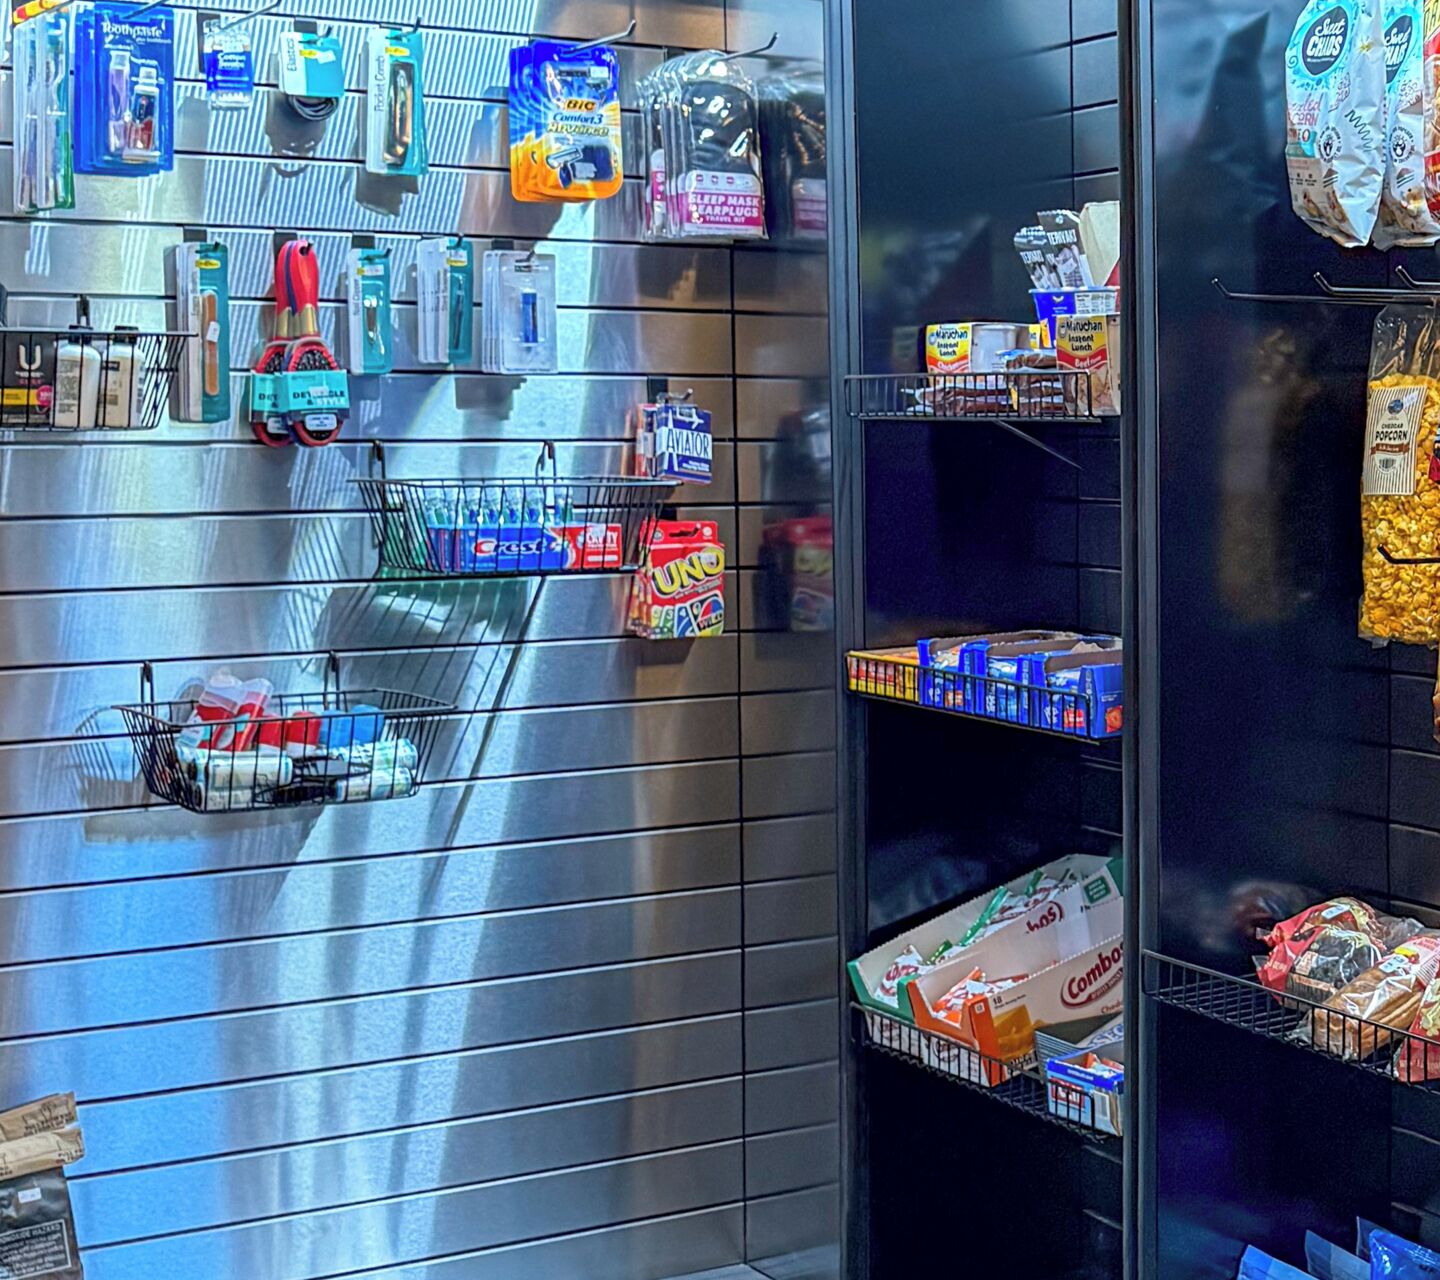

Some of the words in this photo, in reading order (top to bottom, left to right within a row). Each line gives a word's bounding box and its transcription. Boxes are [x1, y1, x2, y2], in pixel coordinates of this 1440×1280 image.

[727, 195, 760, 207] MASK
[697, 205, 759, 218] EARPLUGS
[1066, 319, 1103, 332] Maruchan
[1071, 343, 1092, 352] Lunch
[1375, 430, 1408, 441] POPCORN
[666, 428, 710, 459] AVIATOR
[475, 538, 547, 557] Crest
[653, 546, 725, 597] UNO
